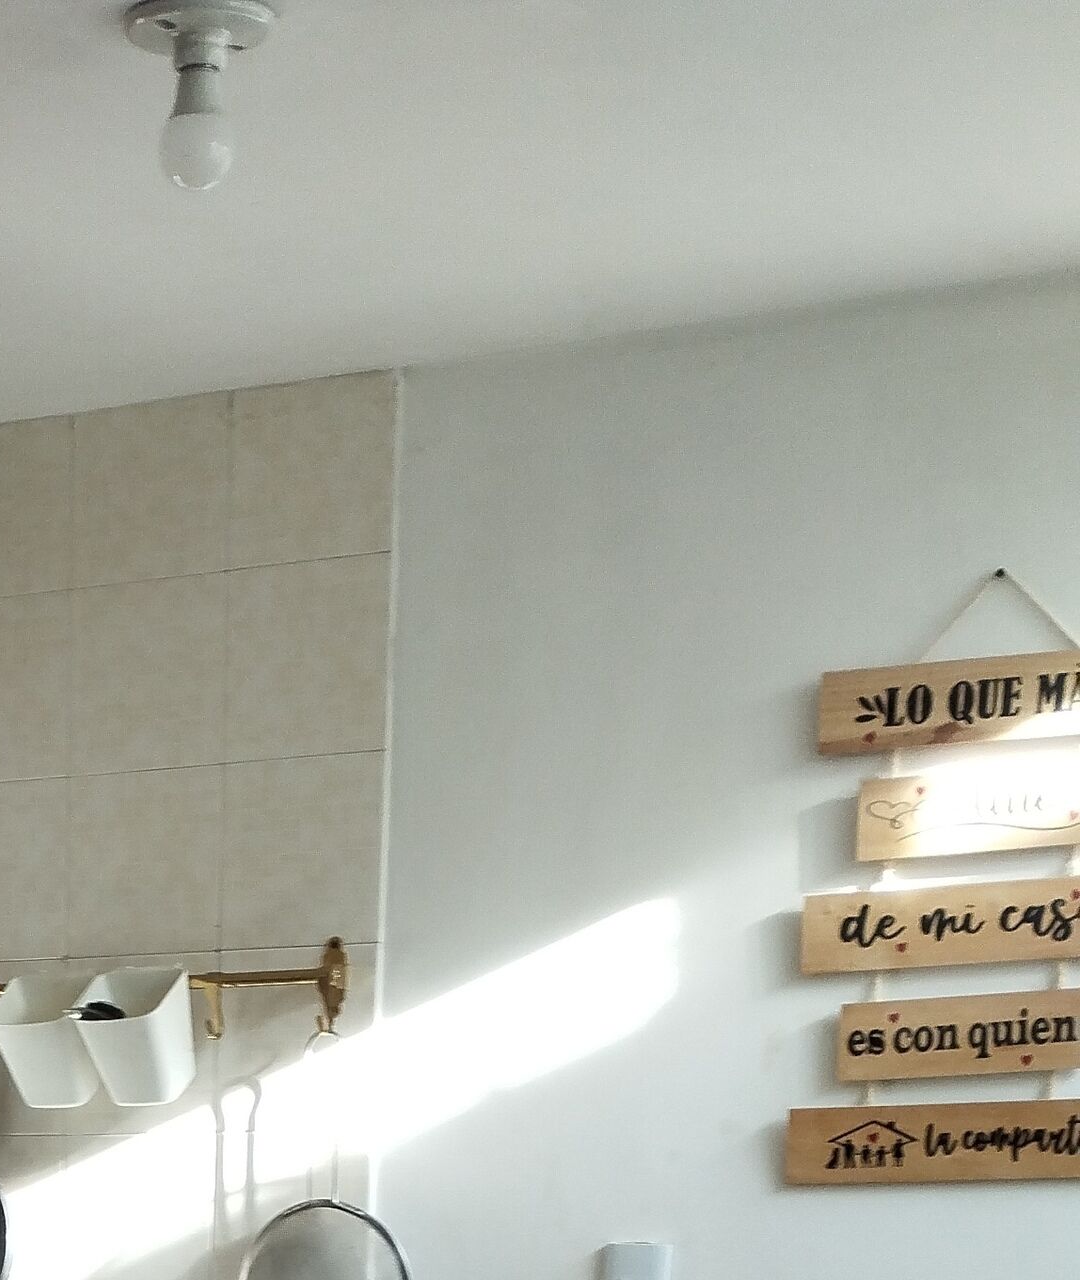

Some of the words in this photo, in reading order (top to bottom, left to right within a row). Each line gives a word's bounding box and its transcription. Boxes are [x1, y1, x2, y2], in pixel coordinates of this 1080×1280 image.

[882, 684, 933, 727] LO
[948, 676, 1023, 724] QUE
[839, 904, 907, 948] de
[920, 904, 986, 941] mi
[998, 898, 1080, 942] cas
[847, 1028, 886, 1056] es
[892, 1023, 961, 1053] con
[969, 1008, 1080, 1059] quien
[924, 1123, 959, 1157] la
[961, 1114, 1080, 1162] compart
